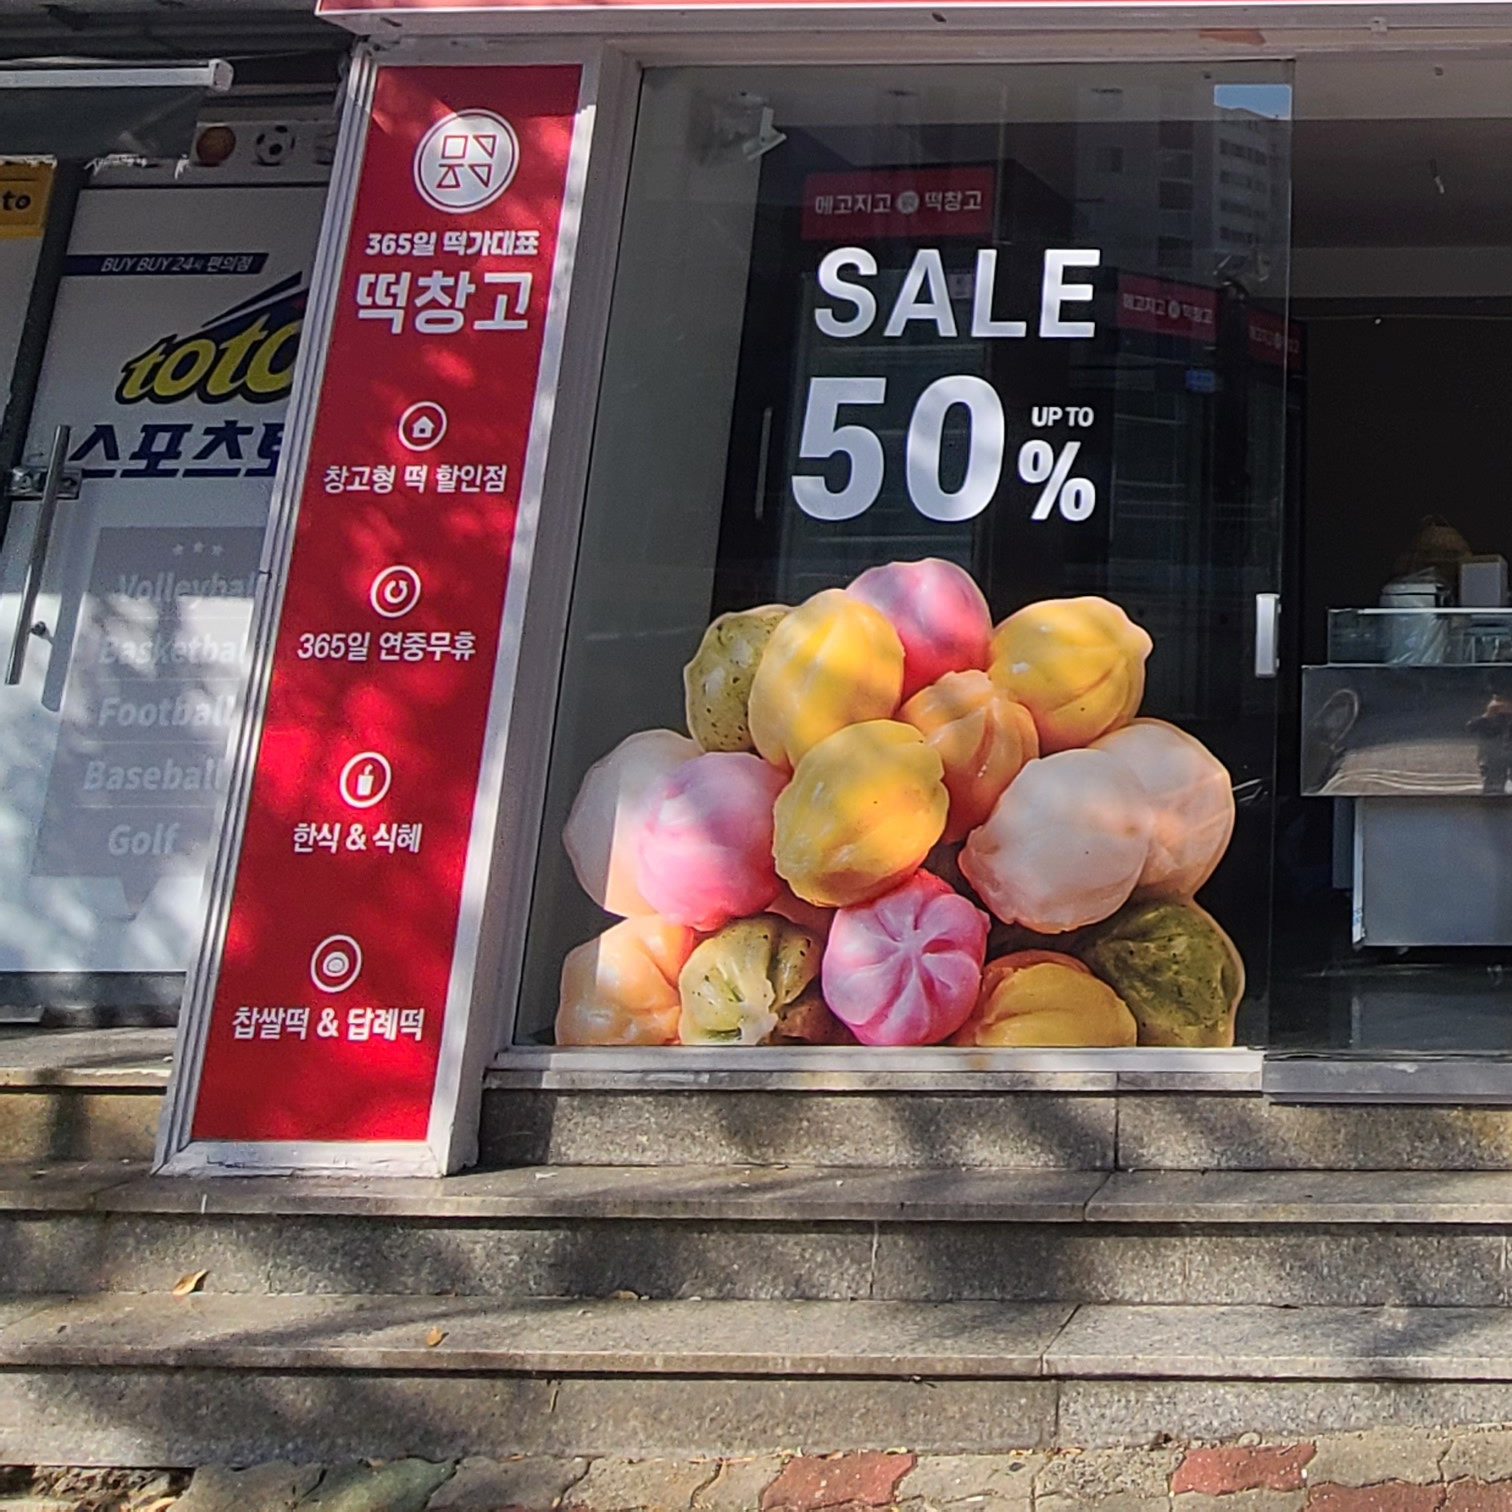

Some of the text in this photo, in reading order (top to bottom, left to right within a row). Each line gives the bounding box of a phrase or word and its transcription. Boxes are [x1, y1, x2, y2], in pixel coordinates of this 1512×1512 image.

[365, 230, 540, 256] 365일 떡가대표
[101, 257, 136, 272] BUY
[136, 257, 172, 272] BUY
[356, 269, 533, 334] 떡창고
[813, 246, 1101, 338] SALE
[1031, 406, 1095, 427] UP TO
[323, 464, 507, 494] 창고형 떡 할인점
[297, 631, 476, 661] 365일 연중무휴
[108, 822, 181, 857] Golf
[293, 823, 422, 854] 한식 & 식혜
[232, 1006, 425, 1041] 찹쌀떡 & 답례떡
